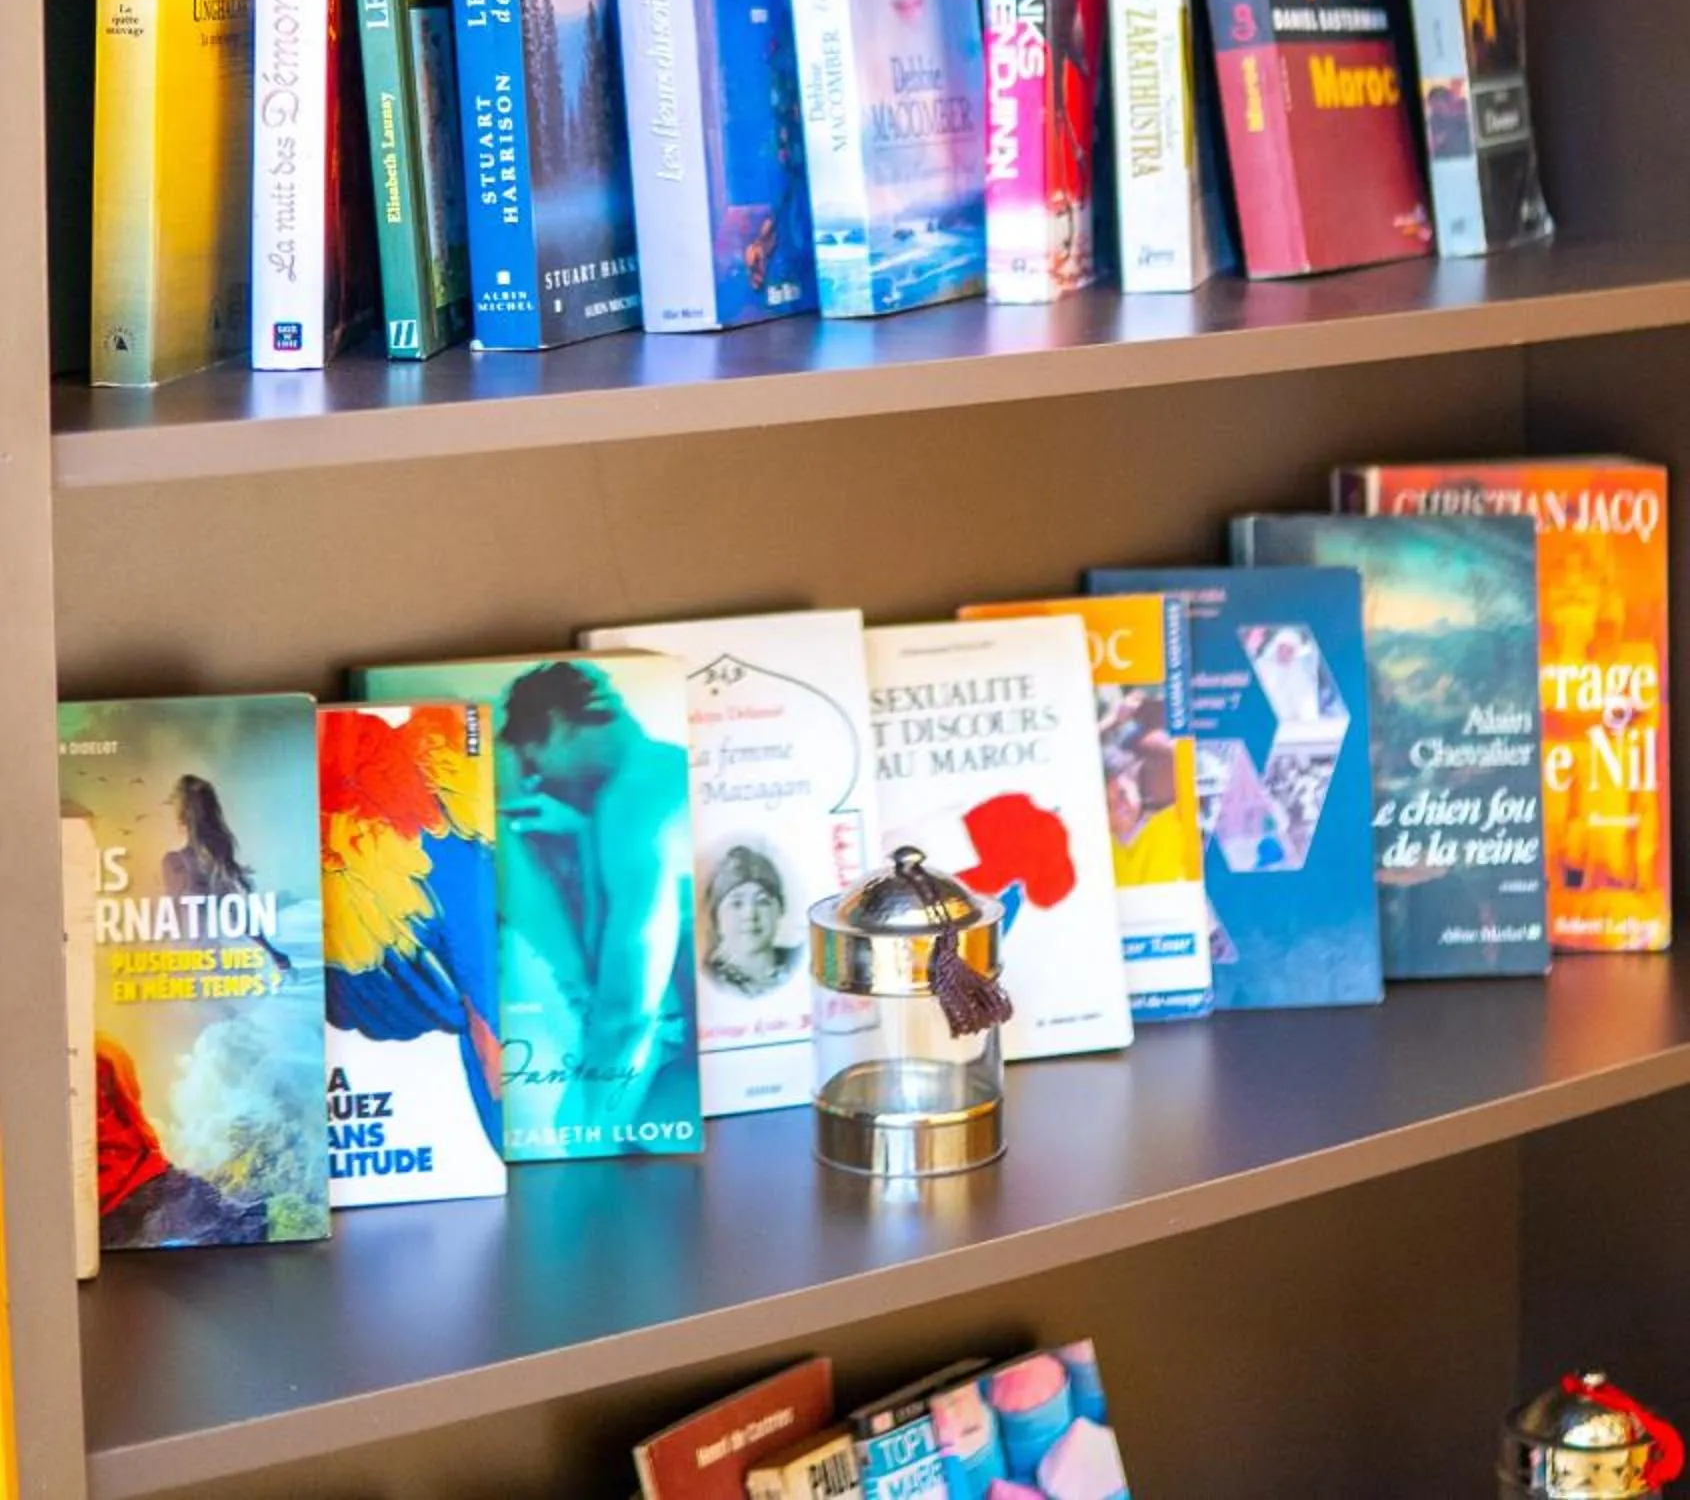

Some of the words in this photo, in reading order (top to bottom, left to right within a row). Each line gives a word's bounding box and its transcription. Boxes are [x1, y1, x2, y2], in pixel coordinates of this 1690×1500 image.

[1272, 8, 1319, 31] DANIEL
[1125, 7, 1163, 179] ZARATHUSTRA
[1308, 53, 1400, 110] Maroc
[474, 95, 499, 206] STUART
[495, 74, 520, 226] HARRISON
[543, 263, 597, 291] STUART
[477, 300, 535, 312] MICHEL
[1572, 487, 1660, 544] JACQ
[902, 704, 1060, 745] DISCOURS
[1462, 703, 1534, 736] Alain
[876, 751, 914, 780] AU
[930, 738, 1052, 776] MAROC
[1409, 738, 1537, 769] Chevalier
[1588, 722, 1659, 792] Nil
[1400, 788, 1482, 827] chien
[1479, 786, 1538, 833] fou
[1382, 831, 1422, 868] de
[1425, 830, 1459, 867] la
[1463, 827, 1540, 867] reine
[111, 950, 216, 973] PLUSIEURS
[222, 947, 264, 969] VIES
[113, 979, 140, 1002] EN
[144, 972, 196, 998] MÊME
[201, 973, 264, 997] TEMPS
[613, 1121, 694, 1143] LLOYD
